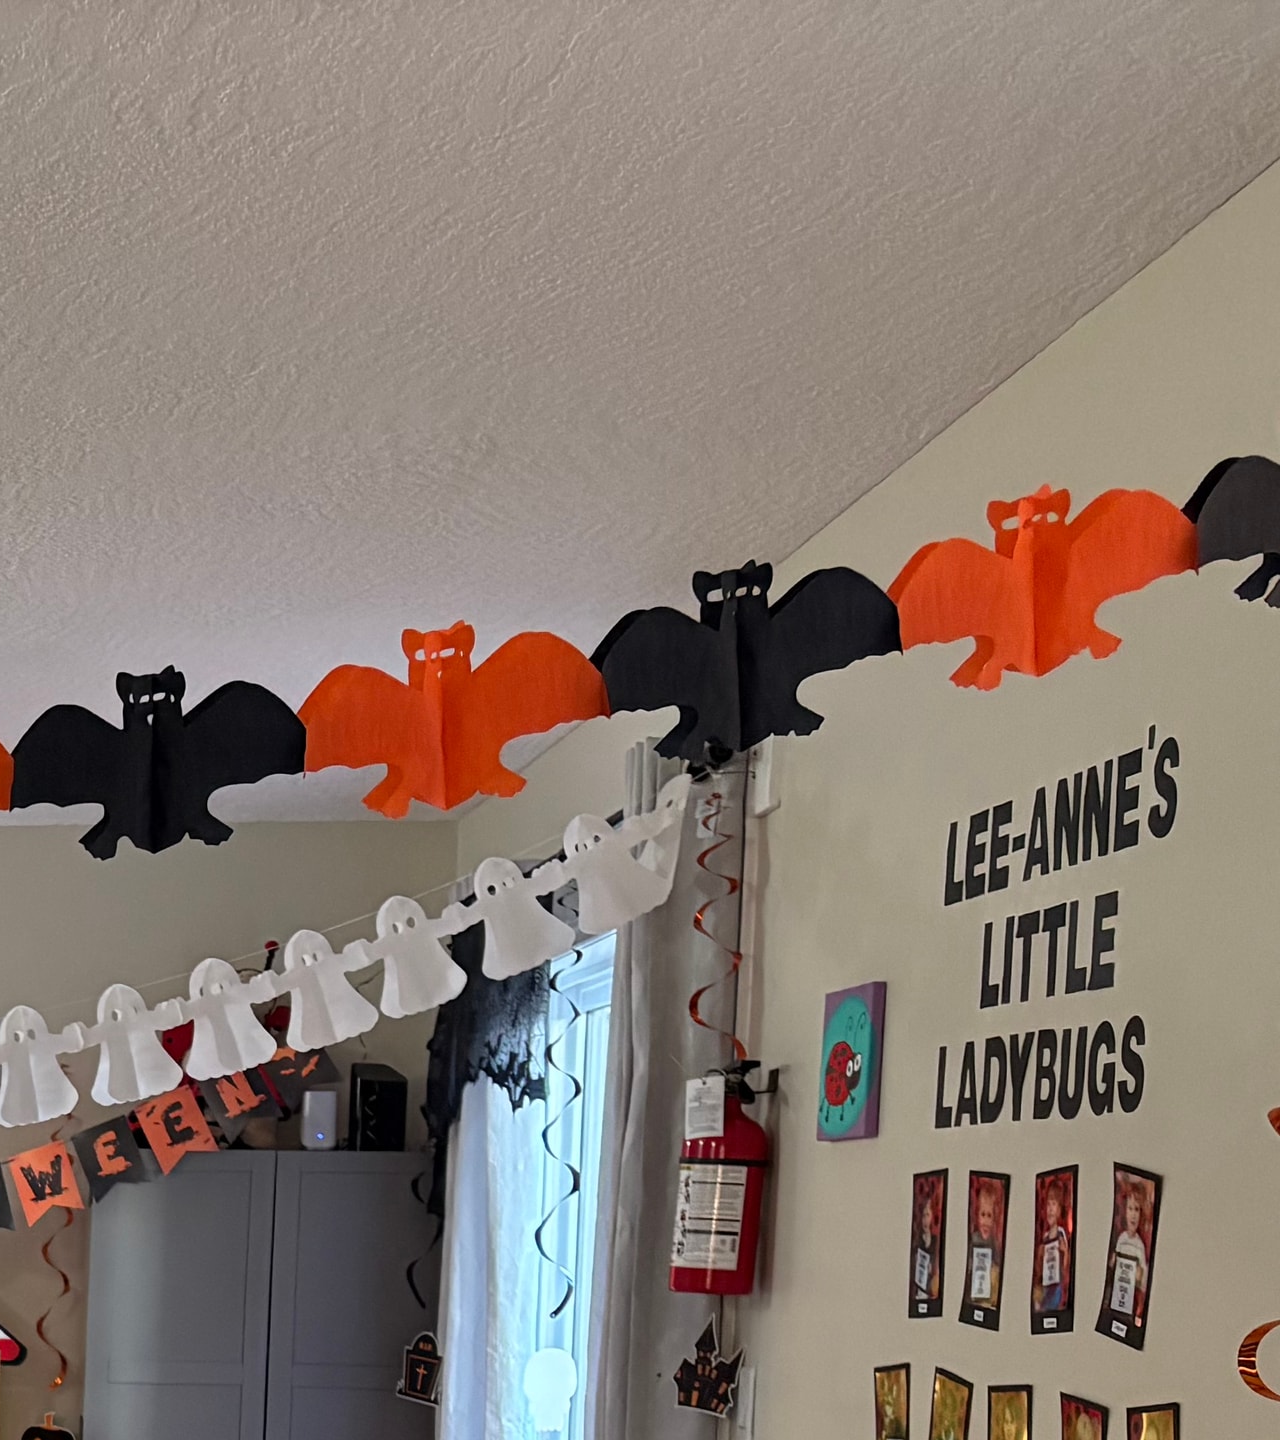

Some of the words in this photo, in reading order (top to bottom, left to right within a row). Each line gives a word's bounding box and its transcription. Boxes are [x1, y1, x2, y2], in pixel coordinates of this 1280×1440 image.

[944, 724, 1180, 906] LEE-ANNE'S
[979, 890, 1119, 1010] LITTLE
[934, 1015, 1146, 1129] LADYBUGS
